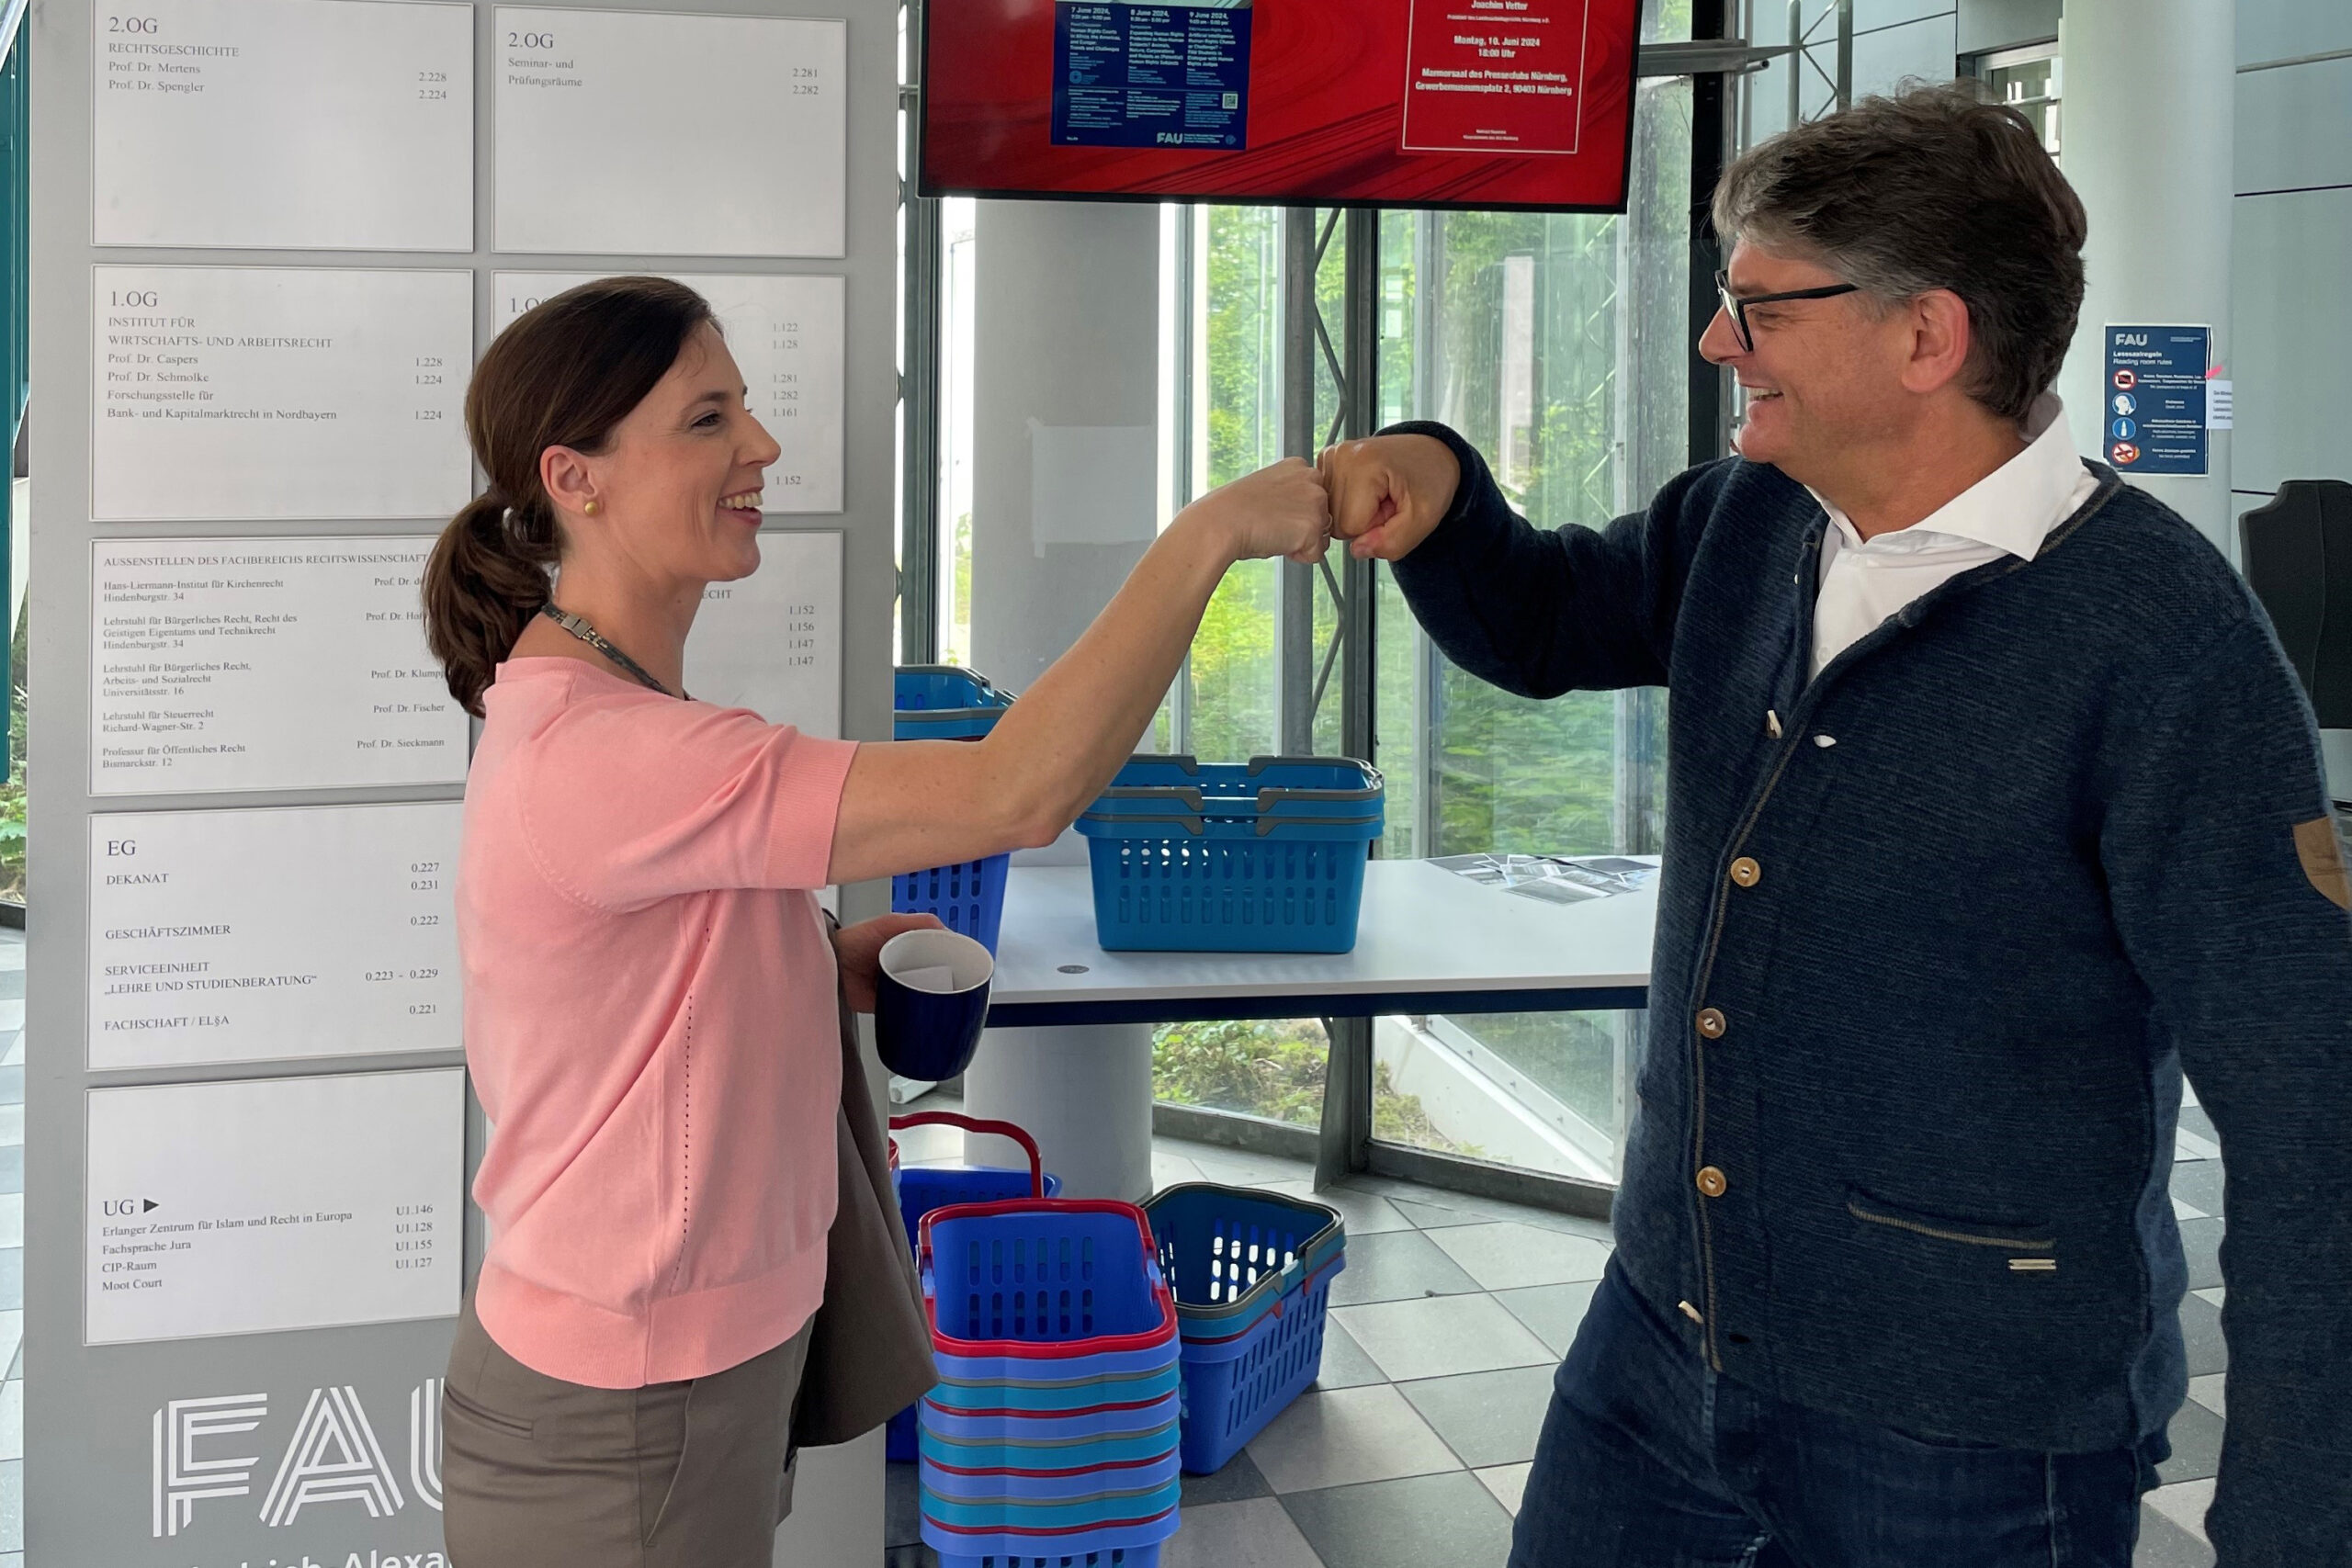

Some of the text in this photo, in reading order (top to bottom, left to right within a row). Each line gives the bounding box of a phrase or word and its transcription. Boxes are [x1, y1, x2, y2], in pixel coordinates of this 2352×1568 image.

[108, 17, 158, 34] 2.OG
[508, 32, 554, 49] 2.OG
[108, 43, 239, 58] RECHTSGESCHICHTE
[108, 62, 200, 73] Prof. Dr. Mertens
[508, 58, 573, 69] Seminar- und
[419, 72, 447, 82] 2.228
[793, 68, 818, 78] 2.281
[108, 80, 205, 94] Prof. Dr. Spengler
[508, 75, 582, 88] Prüfungsräume
[419, 90, 447, 100] 2.224
[793, 85, 819, 95] 2.282
[1157, 132, 1182, 144] FAU
[111, 291, 158, 308] 1.OG
[511, 297, 548, 313] 1.O
[108, 316, 195, 328] INSTITUT FÜR
[773, 323, 798, 333] 1.122
[108, 336, 332, 348] WIRTSCHAFTS- UND ARBEITSRECHT
[773, 340, 798, 349] 1.128
[2115, 333, 2147, 346] FAU
[108, 354, 198, 367] Prof. Dr. Caspers
[415, 357, 442, 367] 1.228
[108, 372, 209, 383] Prof. Dr. Schmolke
[415, 375, 442, 385] 1.224
[773, 374, 798, 383] 1.281
[107, 389, 213, 401] Forschungsstelle für
[773, 390, 798, 400] 1.282
[107, 409, 336, 422] Bank- und Kapitalmarktrecht in Nordbayern
[415, 411, 442, 420] 1.224
[773, 408, 798, 417] 1.161
[775, 476, 801, 485] 1.152
[104, 557, 195, 567] AUSSENSTELLEN
[198, 557, 218, 566] DES
[221, 555, 302, 565] FACHBEREICHS
[104, 579, 284, 591] Hans-Liermann-Institut für Kirchenrecht
[374, 577, 412, 587] Prof. Dr.
[104, 592, 184, 604] Hindenburgstr. 34
[789, 606, 814, 615] 1.152
[104, 614, 298, 626] Lehrstuhl für Bürgerliches Recht, Recht des
[366, 613, 387, 621] Prof.
[390, 612, 404, 621] Dr.
[104, 626, 276, 638] Geistigen Eigentums und Technikrecht
[789, 623, 814, 631] 1.156
[104, 639, 184, 650] Hindenburgstr. 34
[104, 661, 251, 673] Lehrstuhl für Bürgerliches Recht,
[104, 674, 210, 684] Arbeits- und Sozialrecht
[371, 670, 391, 680] Prof.
[395, 670, 409, 679] Dr.
[104, 686, 184, 697] Universitätsstr. 16
[373, 703, 445, 714] Prof. Dr. Fischer
[103, 710, 214, 720] Lehrstuhl für Steuerrecht
[103, 722, 204, 733] Richard-Wagner-Str. 2
[357, 738, 445, 749] Prof. Dr. Sieckmann
[103, 744, 245, 757] Professur für Öffentliches Recht
[103, 758, 172, 769] Bismarckstr. 12
[107, 840, 136, 855] EG
[412, 863, 439, 873] 0.227
[107, 874, 168, 885] DEKANAT
[411, 880, 438, 890] 0.231
[411, 916, 438, 926] 0.222
[106, 924, 231, 940] GESCHÄFTSZIMMER
[106, 962, 209, 976] SERVICEEINHEIT
[366, 972, 394, 982] 0.223
[410, 969, 438, 979] 0.229
[155, 980, 183, 991] UND
[409, 1004, 436, 1015] 0.221
[105, 1017, 188, 1031] FACHSCHAFT
[103, 1200, 134, 1217] UG
[396, 1204, 433, 1216] U1.146
[103, 1212, 352, 1237] Erlanger Zentrum für Islam und Recht in Europa
[396, 1223, 433, 1234] U1.128
[103, 1239, 191, 1256] Fachsprache Jura
[396, 1240, 432, 1251] U1.155
[102, 1260, 157, 1273] CIP-Raum
[395, 1258, 432, 1269] U1.127
[102, 1279, 162, 1292] Moot Court
